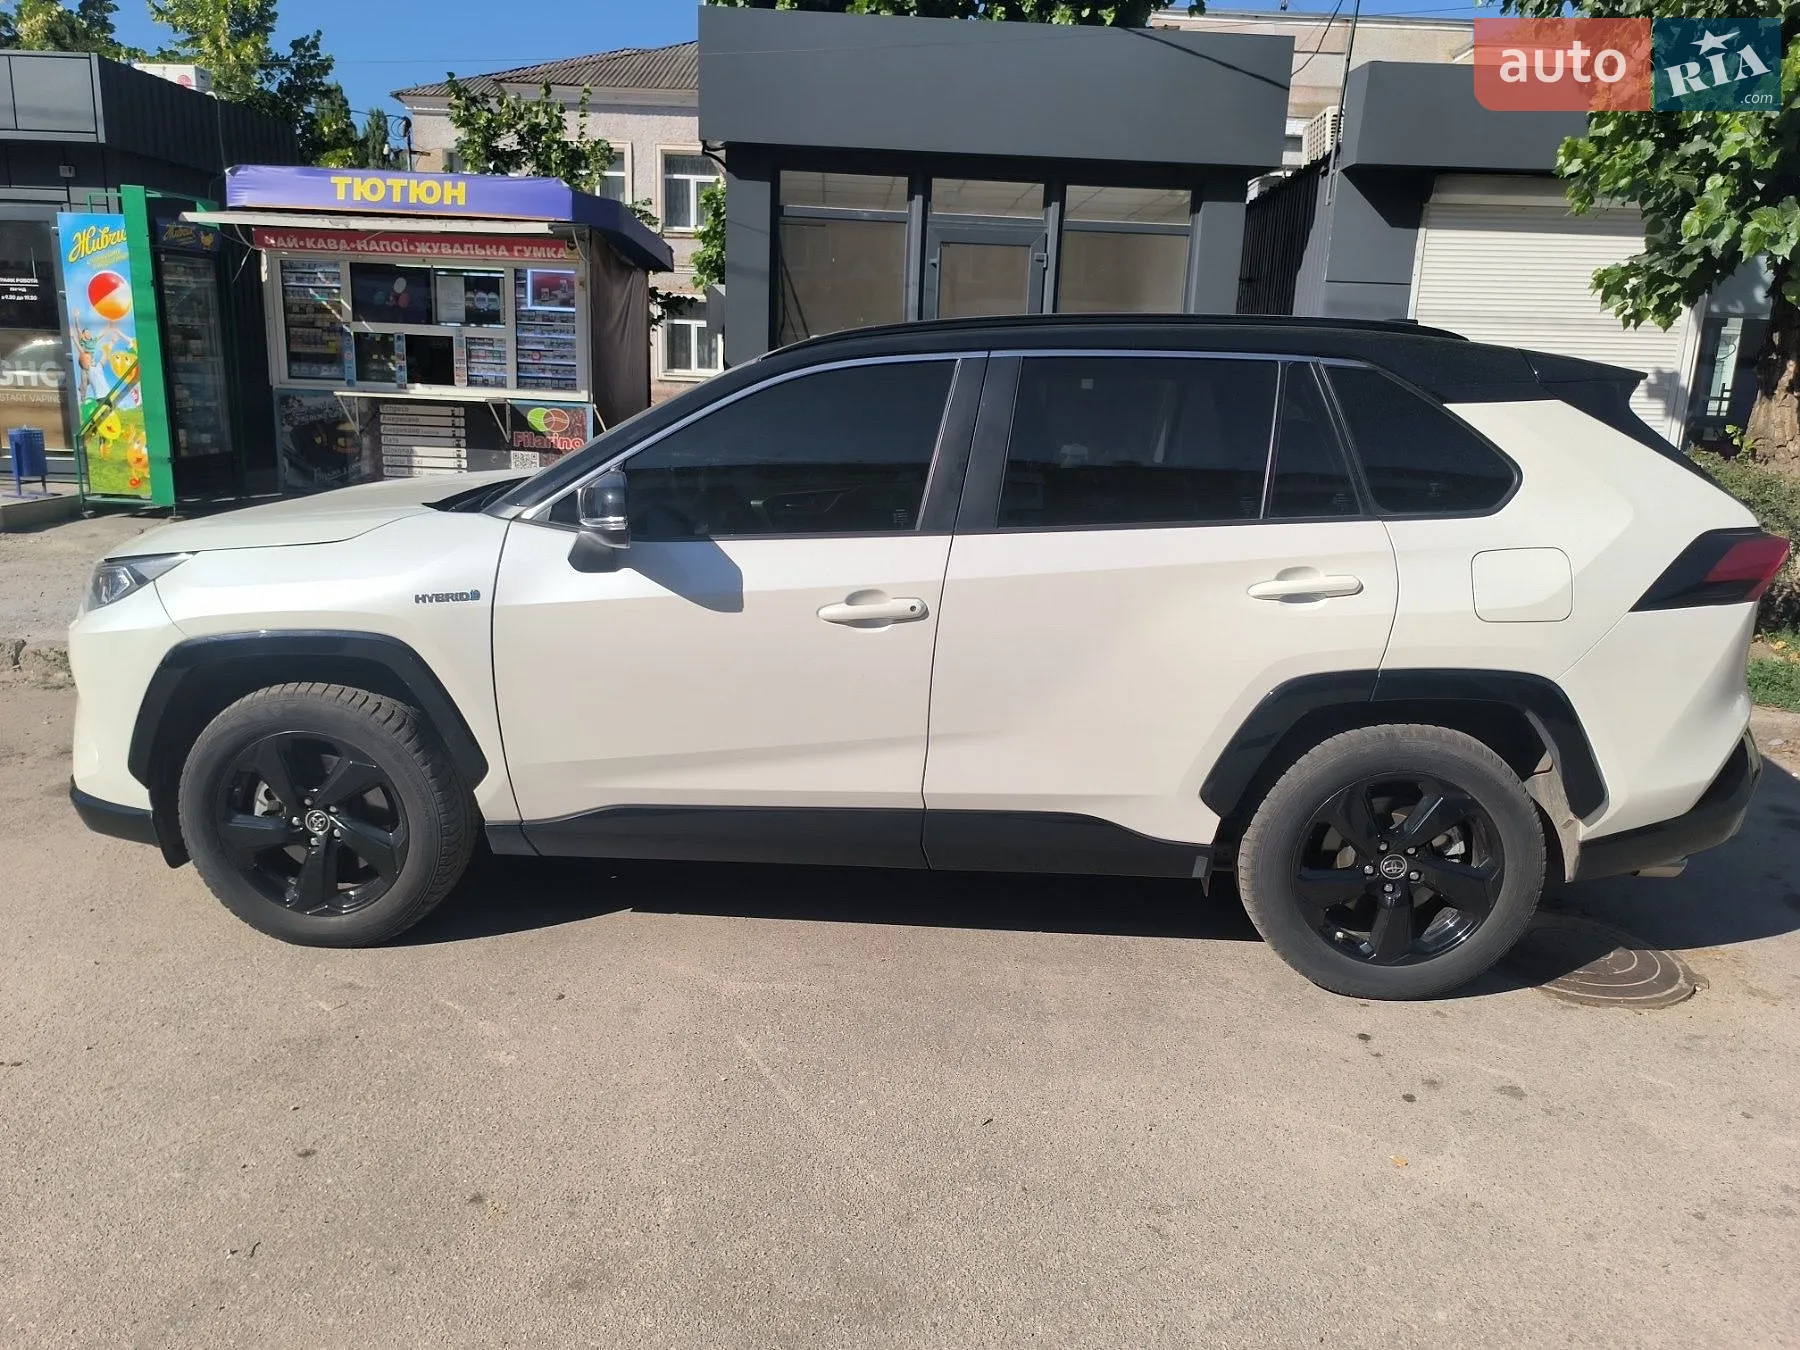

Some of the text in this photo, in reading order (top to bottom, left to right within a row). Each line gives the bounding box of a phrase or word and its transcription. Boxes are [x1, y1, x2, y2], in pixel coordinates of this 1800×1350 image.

[330, 176, 467, 206] ТЮТЮН
[513, 245, 566, 259] ГУМКА
[513, 432, 585, 450] Pilarino
[414, 592, 470, 604] HYBRID
